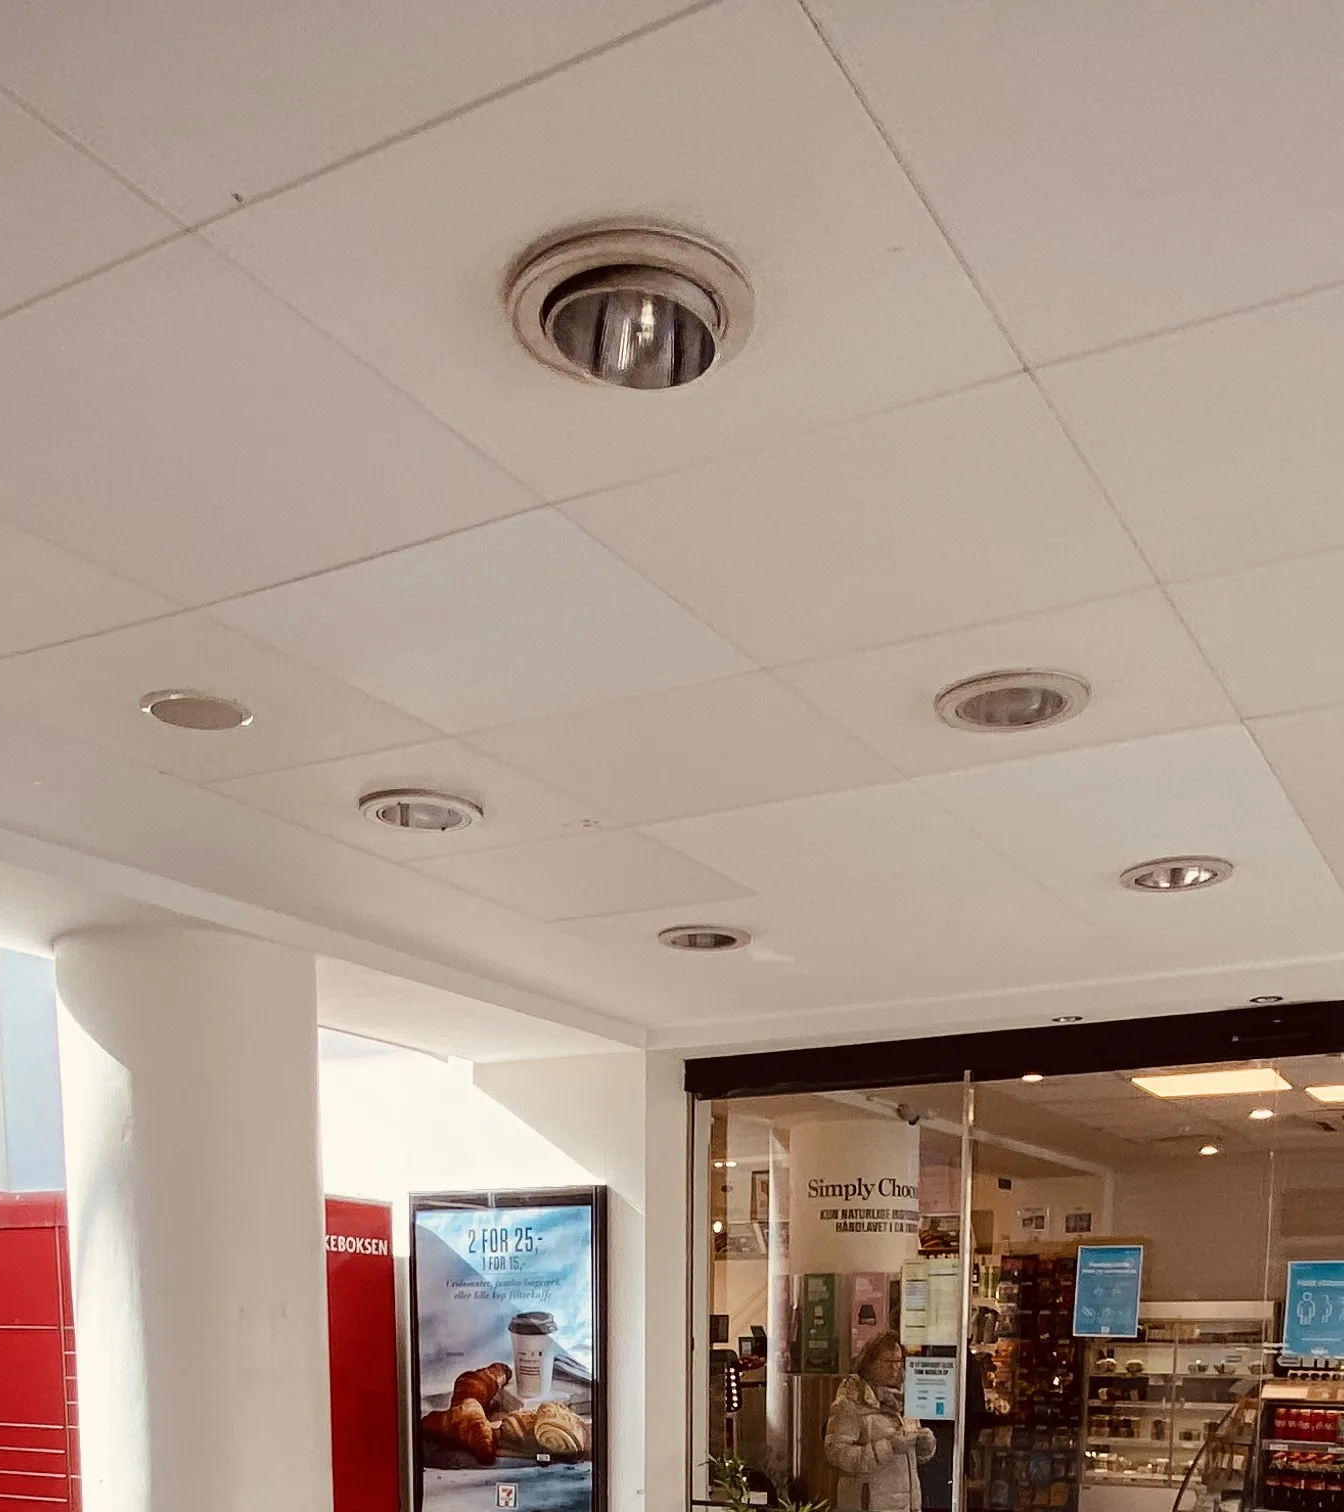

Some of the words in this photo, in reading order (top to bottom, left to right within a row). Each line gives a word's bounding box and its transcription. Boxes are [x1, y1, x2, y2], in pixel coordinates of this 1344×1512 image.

[807, 1177, 875, 1201] Simply
[468, 1229, 476, 1254] 2
[482, 1228, 508, 1253] FOR
[488, 1256, 506, 1271] FOR
